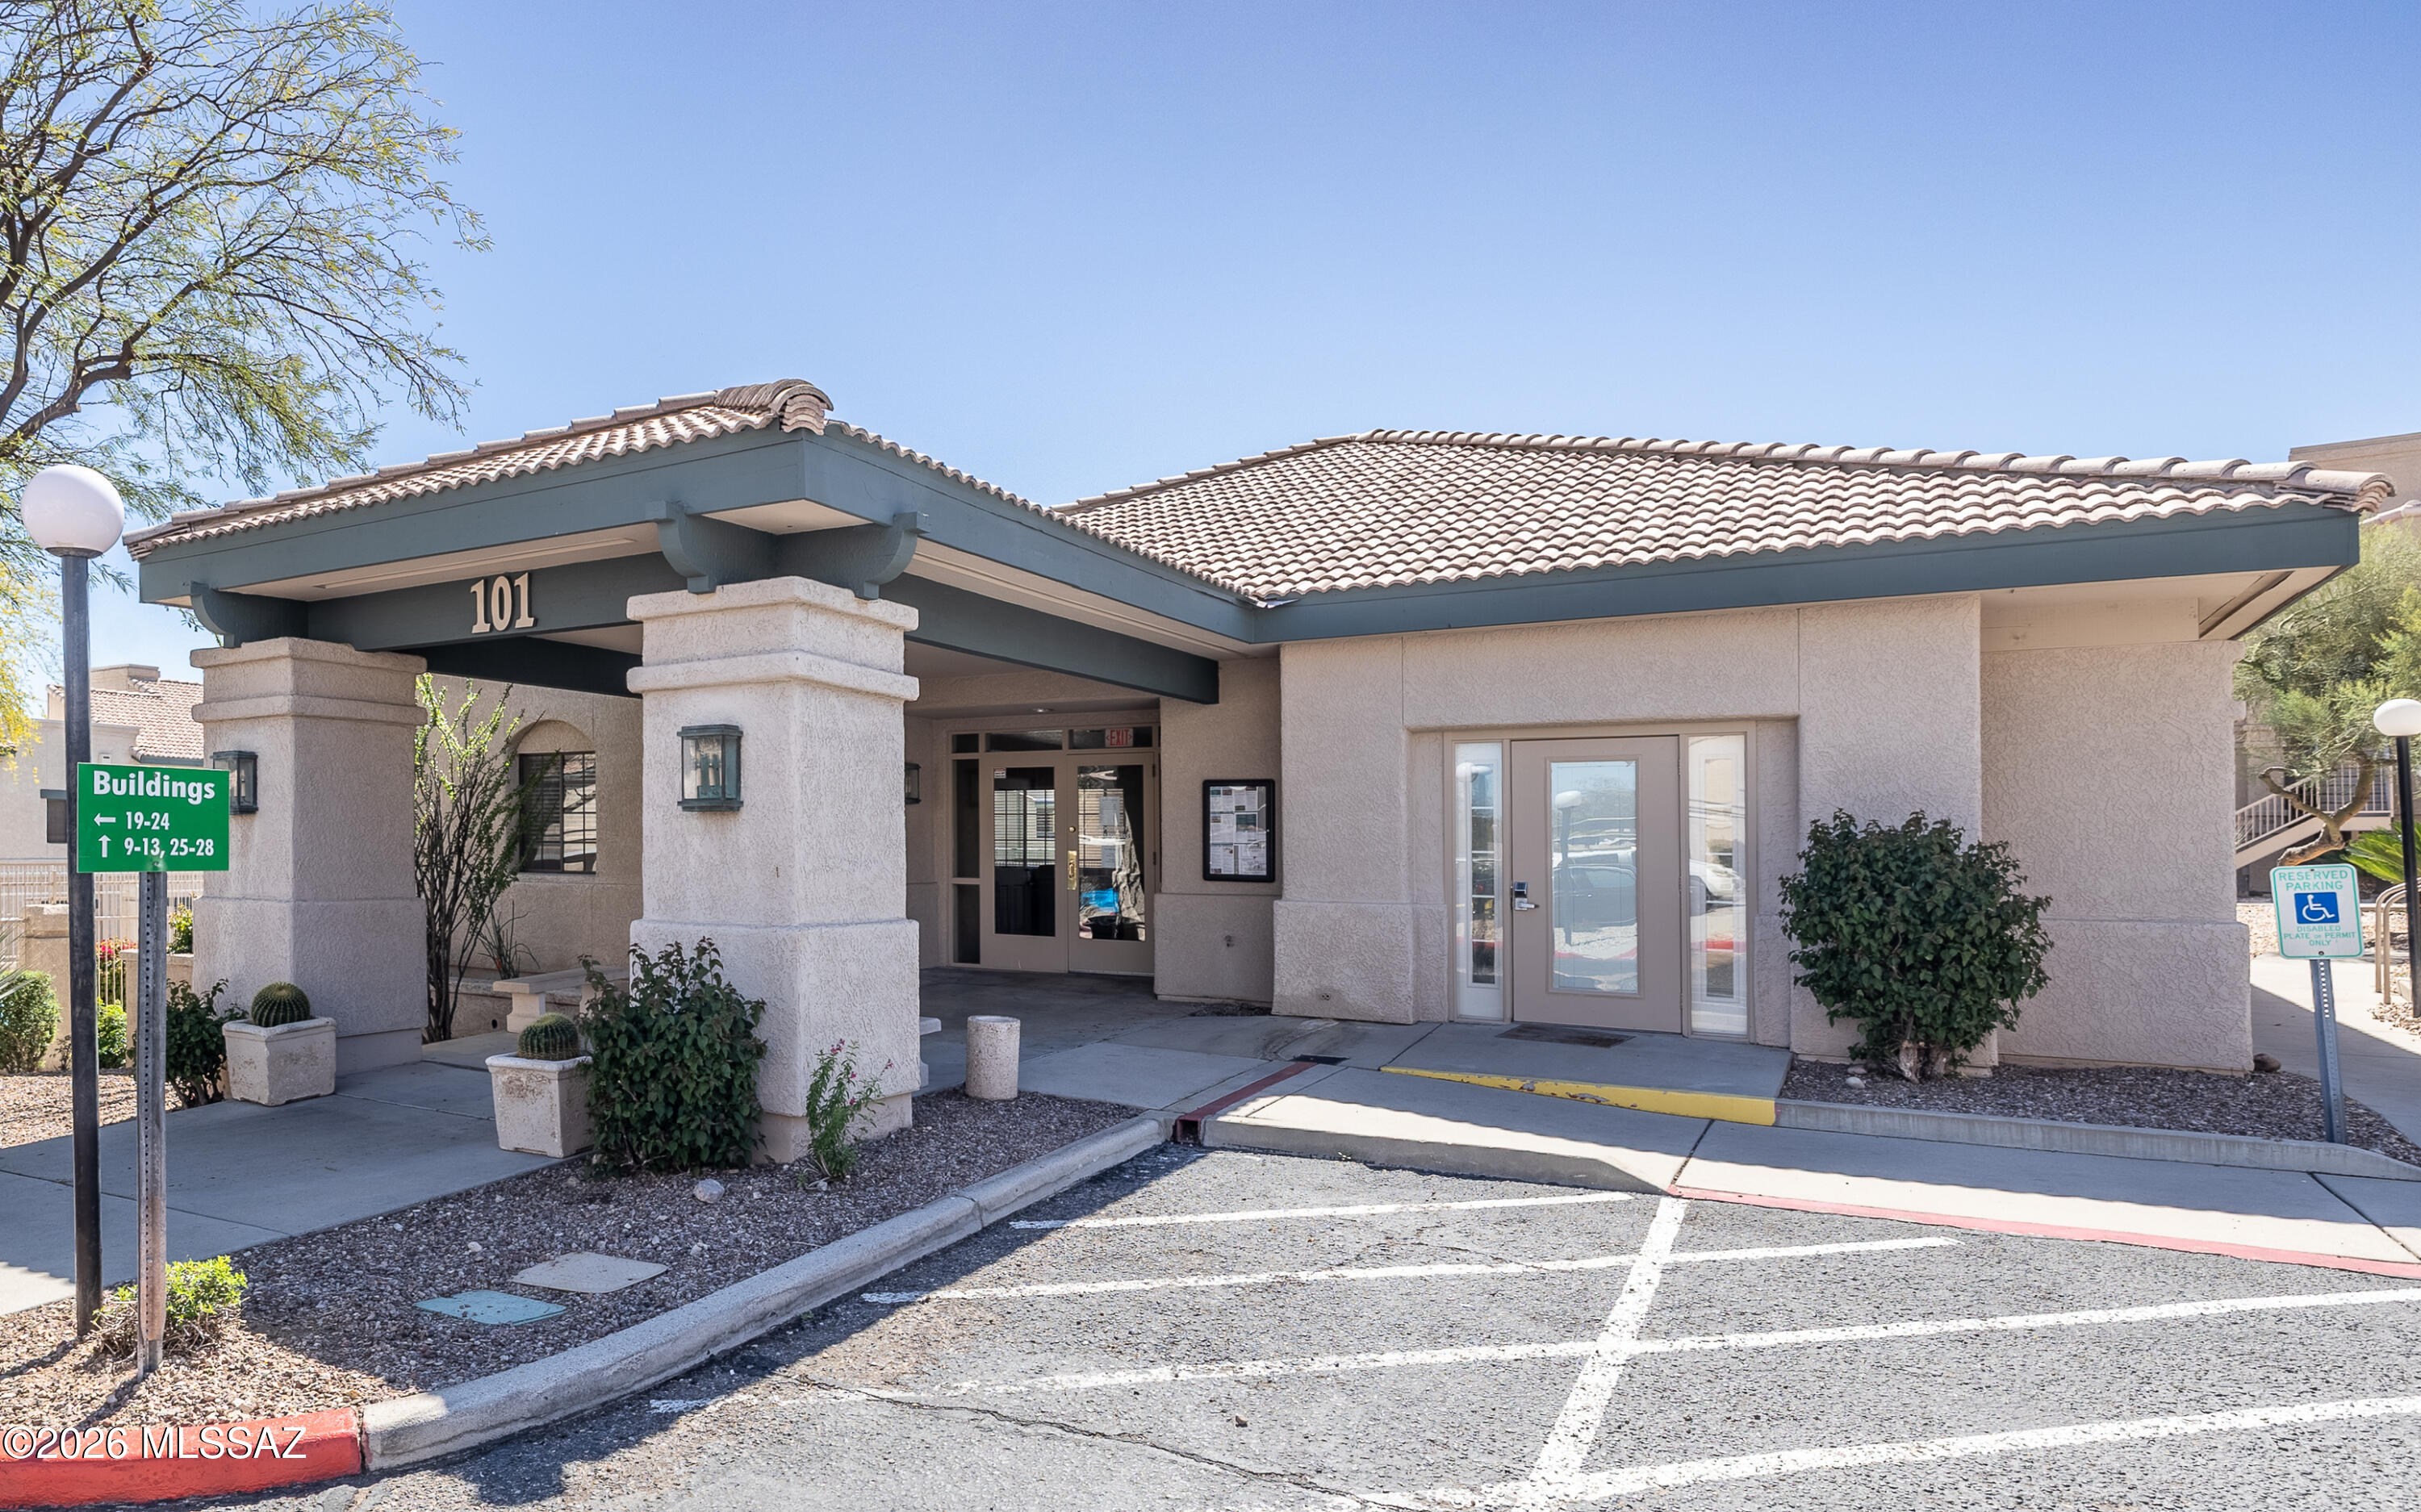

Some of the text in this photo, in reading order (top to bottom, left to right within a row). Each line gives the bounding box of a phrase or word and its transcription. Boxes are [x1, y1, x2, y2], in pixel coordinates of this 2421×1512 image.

[470, 572, 534, 634] 101
[1110, 729, 1129, 746] EXIT
[93, 770, 215, 805] Buildings
[125, 811, 169, 831] 19-24
[123, 837, 215, 858] 9-13, 25-28
[2278, 870, 2348, 882] RESERVED
[2285, 881, 2344, 892] PARKING
[2297, 925, 2341, 933] DISABLED
[2324, 931, 2356, 939] PERMIT
